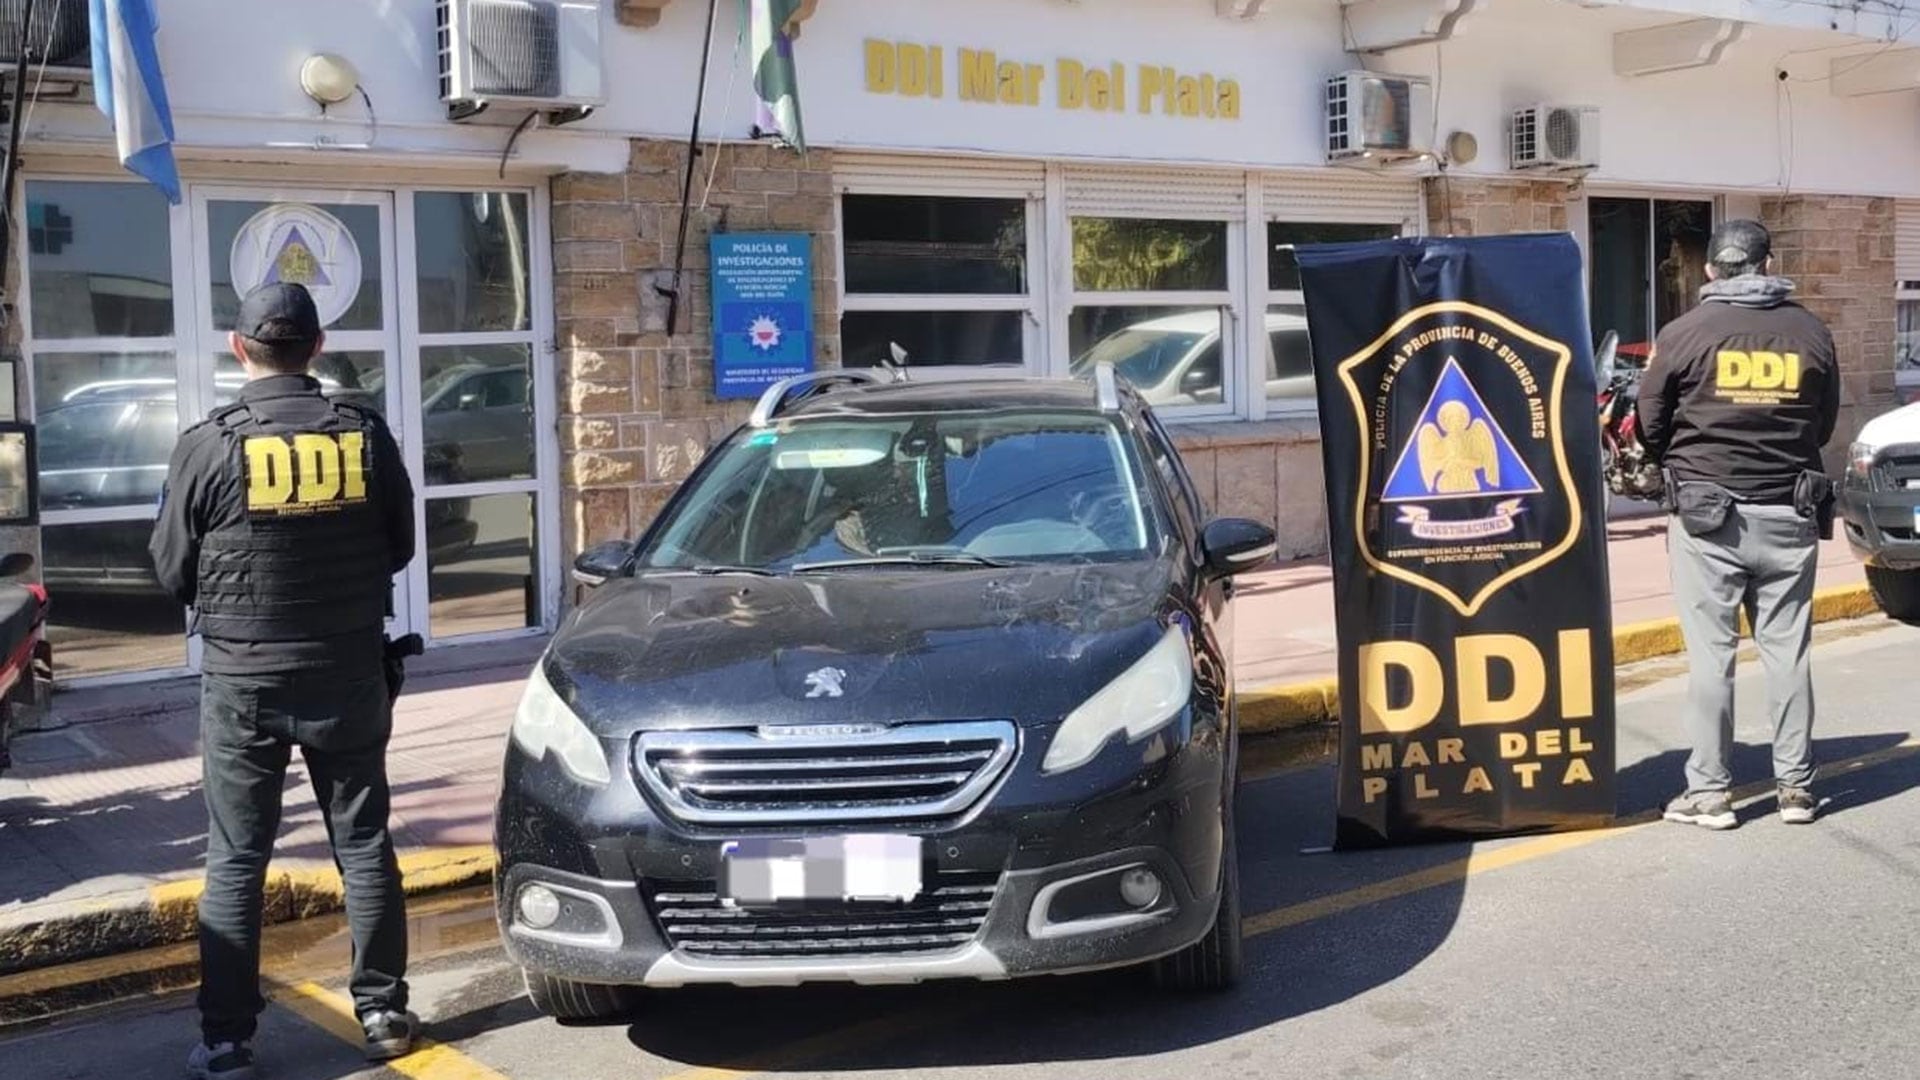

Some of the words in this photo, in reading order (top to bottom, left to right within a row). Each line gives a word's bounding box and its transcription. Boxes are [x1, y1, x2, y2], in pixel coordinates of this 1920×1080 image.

[863, 37, 943, 99] DDI
[957, 46, 1045, 107] Mar
[1055, 57, 1126, 114] Del
[1136, 62, 1241, 121] Plata
[718, 256, 804, 266] INVESTIGACIONES
[775, 243, 789, 253] DE
[1402, 326, 1475, 357] PROVINCIA
[1478, 332, 1499, 351] DE
[1380, 374, 1395, 393] DE
[1389, 353, 1406, 373] LA
[1497, 345, 1538, 395] BUENOS
[1716, 350, 1799, 390] DDI
[1375, 396, 1387, 450] POLICIA
[1528, 397, 1546, 440] AIRES
[244, 431, 366, 505] DDI
[1418, 519, 1510, 536] INVESTIGACIONES
[1359, 628, 1593, 734] DDI
[1361, 738, 1466, 771] MAR
[1500, 727, 1593, 758] DEL
[1363, 758, 1593, 803] PLATA
